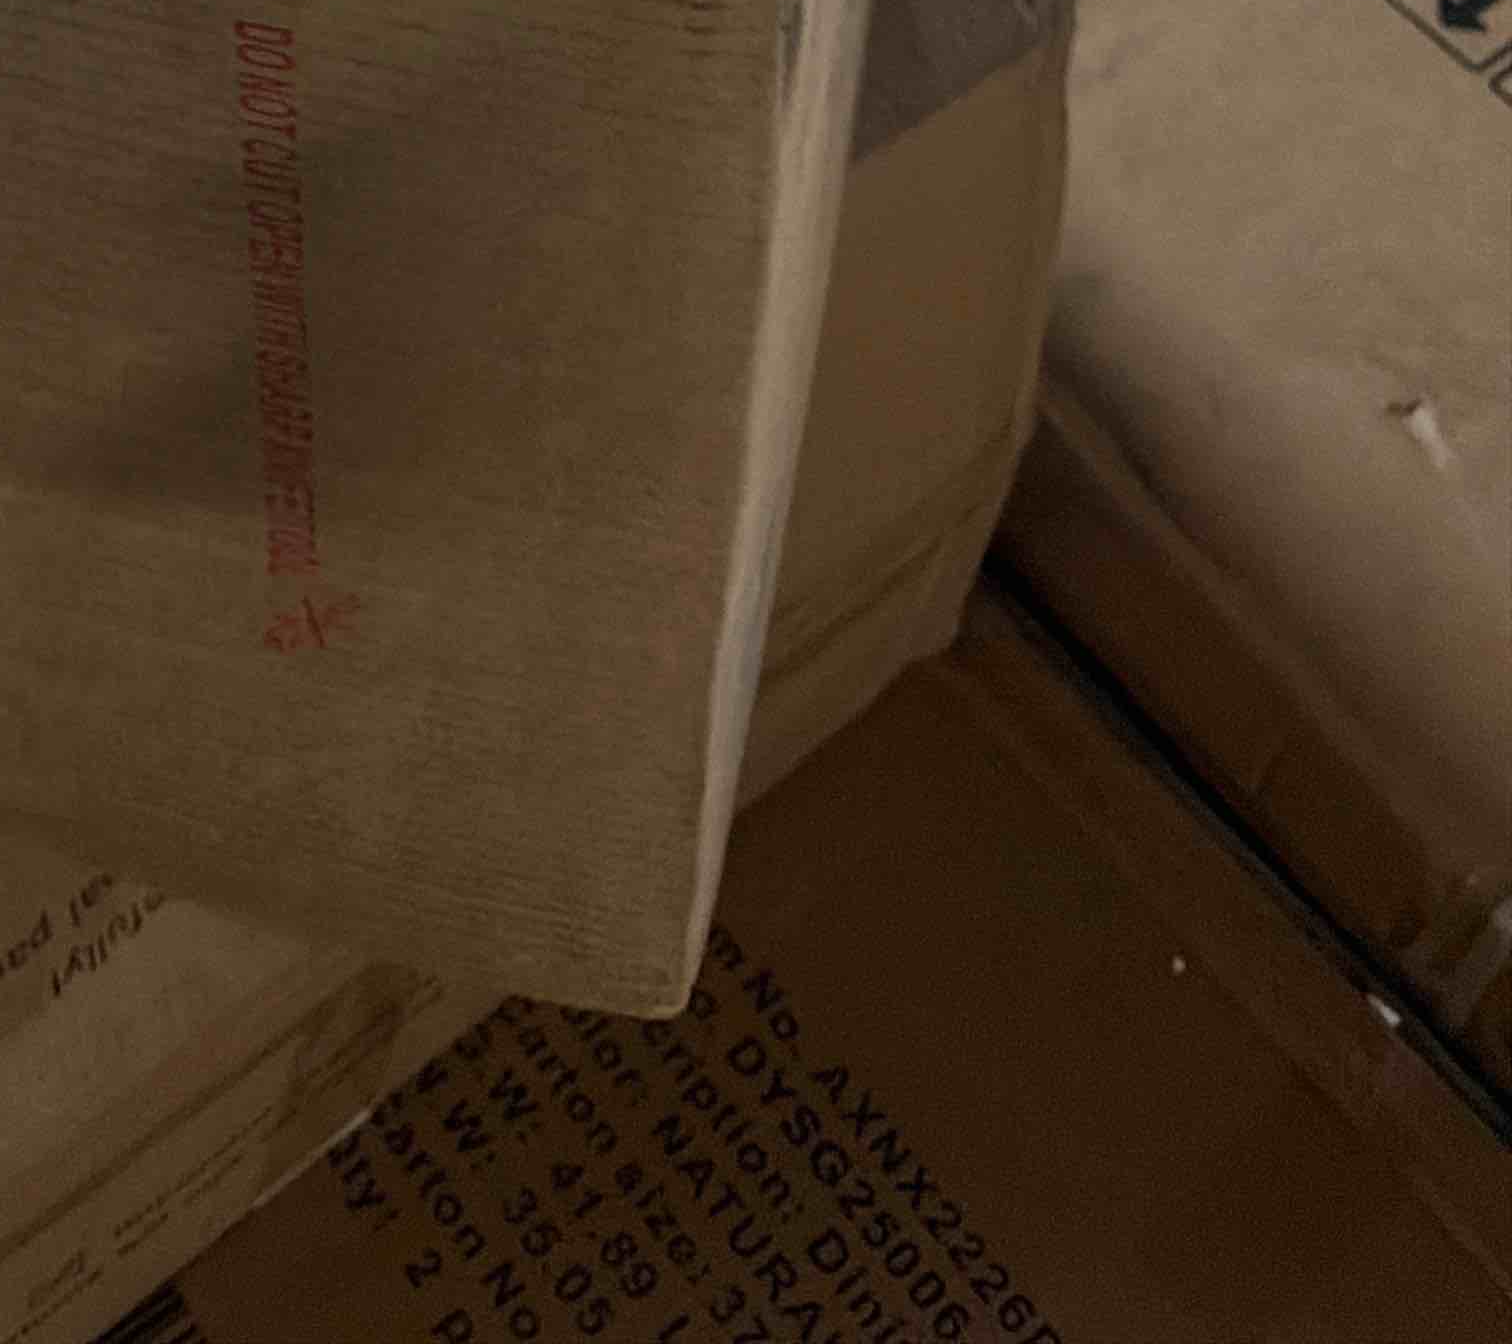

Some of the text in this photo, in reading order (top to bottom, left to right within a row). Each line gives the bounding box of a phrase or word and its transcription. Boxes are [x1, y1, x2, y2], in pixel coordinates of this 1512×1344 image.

[234, 21, 297, 69] DO
[238, 72, 297, 138] NOT
[648, 1114, 843, 1344] NATURA
[405, 1248, 440, 1288] 2
[808, 1225, 909, 1344] Dini
